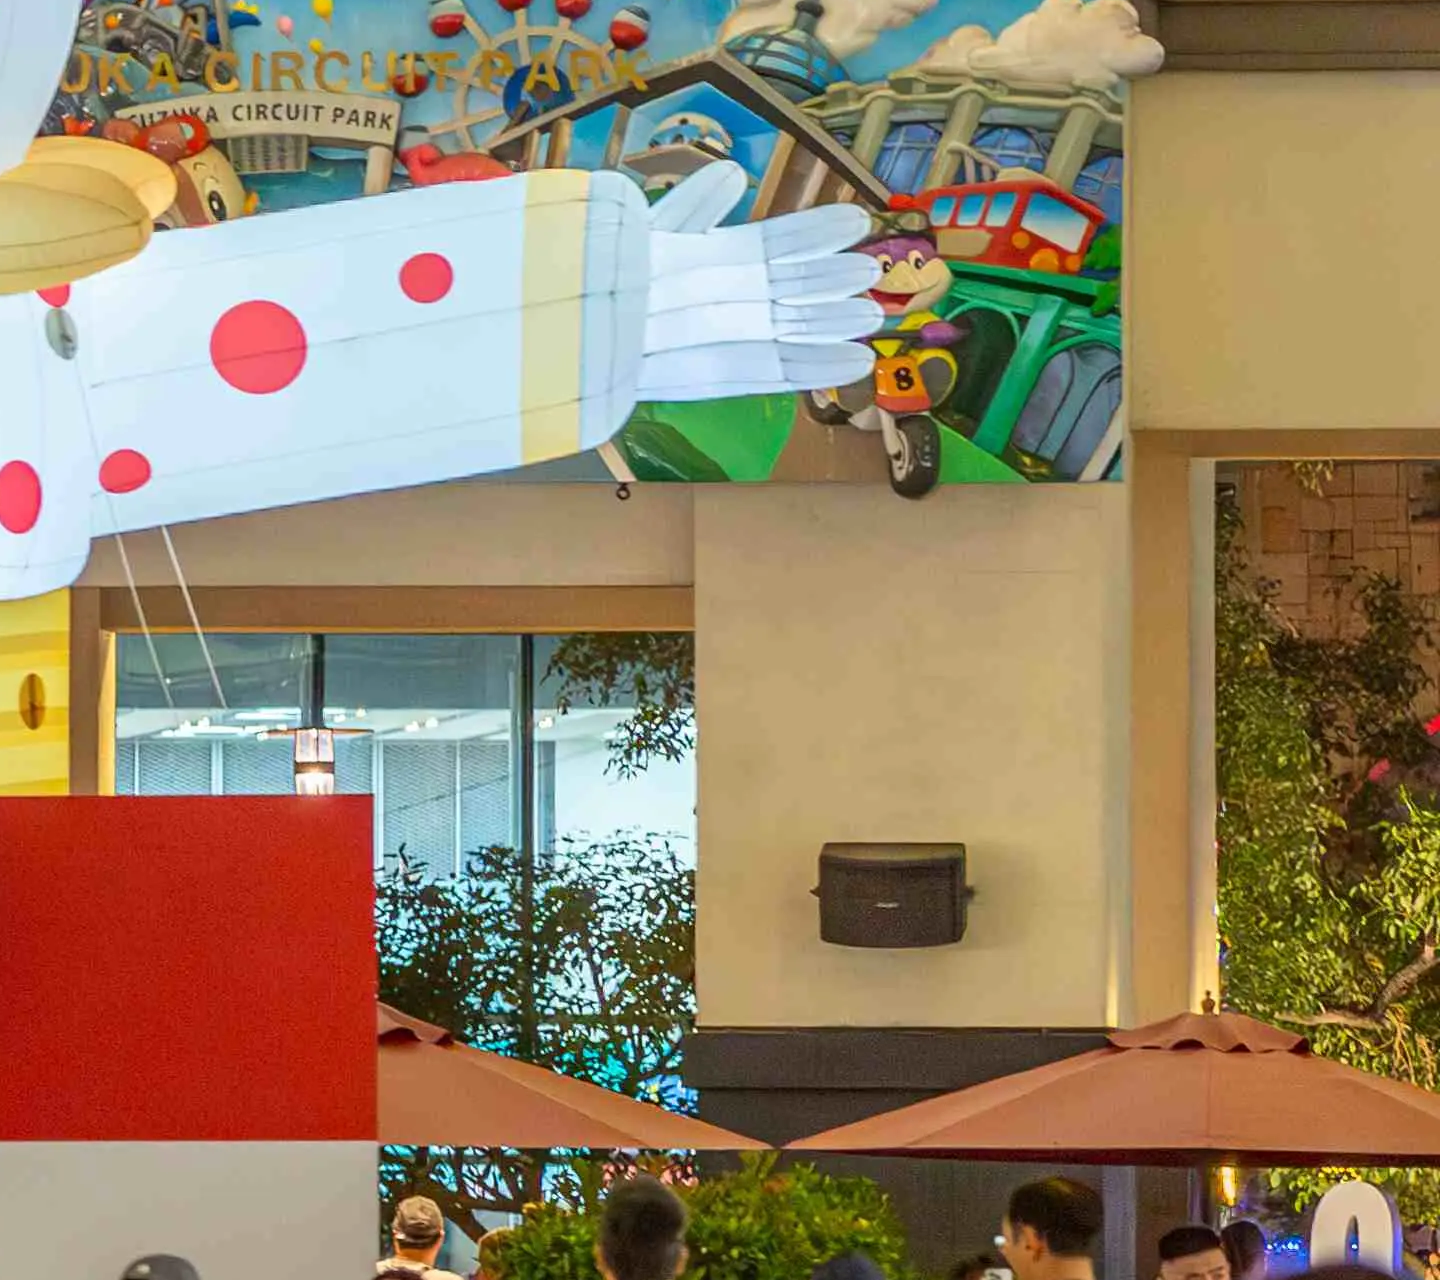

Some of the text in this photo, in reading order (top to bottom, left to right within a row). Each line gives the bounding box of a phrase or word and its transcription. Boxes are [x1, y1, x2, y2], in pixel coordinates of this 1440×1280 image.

[205, 50, 459, 95] CIRCUIT
[480, 50, 649, 92] PARK
[231, 103, 325, 123] CIRCUIT
[330, 106, 394, 132] PARK
[893, 367, 915, 391] 8
